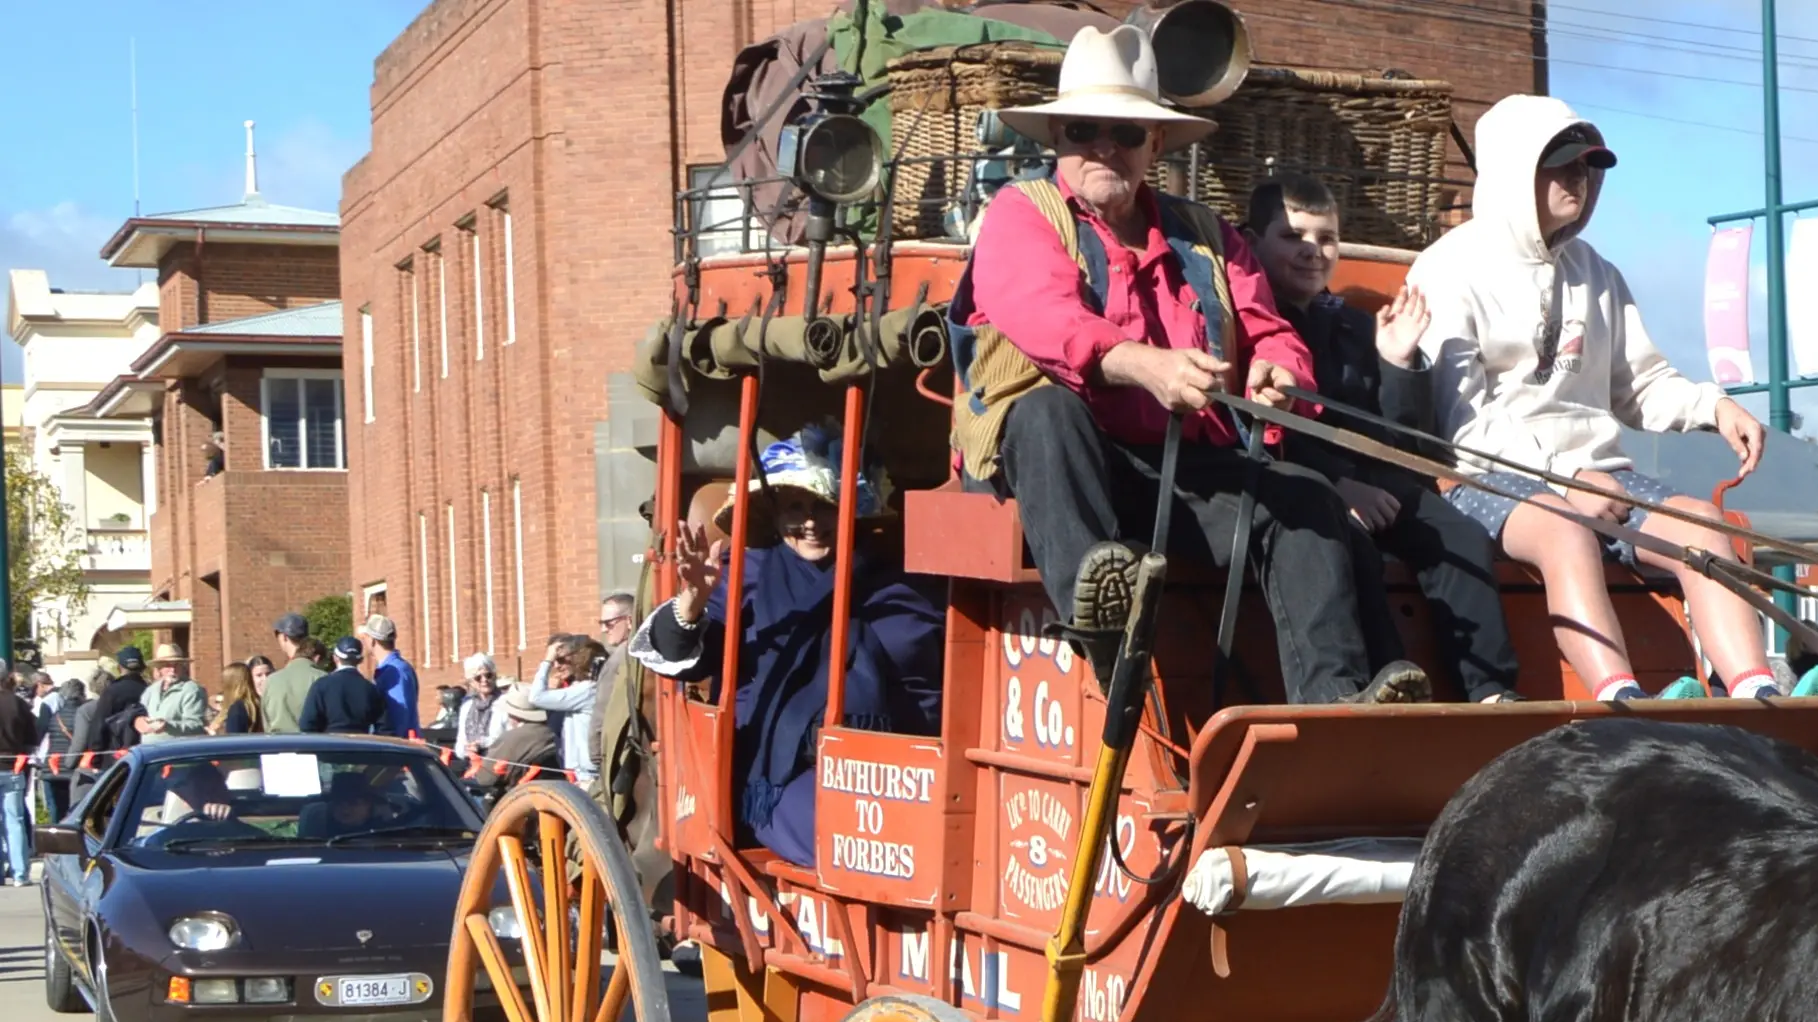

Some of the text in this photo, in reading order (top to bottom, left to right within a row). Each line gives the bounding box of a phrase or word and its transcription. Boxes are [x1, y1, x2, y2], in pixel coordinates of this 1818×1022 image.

[1005, 676, 1075, 745] & Co.
[822, 755, 935, 802] BATHURST
[855, 799, 884, 835] TO
[1028, 789, 1040, 822] TO
[832, 833, 915, 879] FORBES
[1028, 835, 1047, 865] 8
[1005, 853, 1069, 911] PASSENGERS
[345, 981, 407, 998] 81384 J
